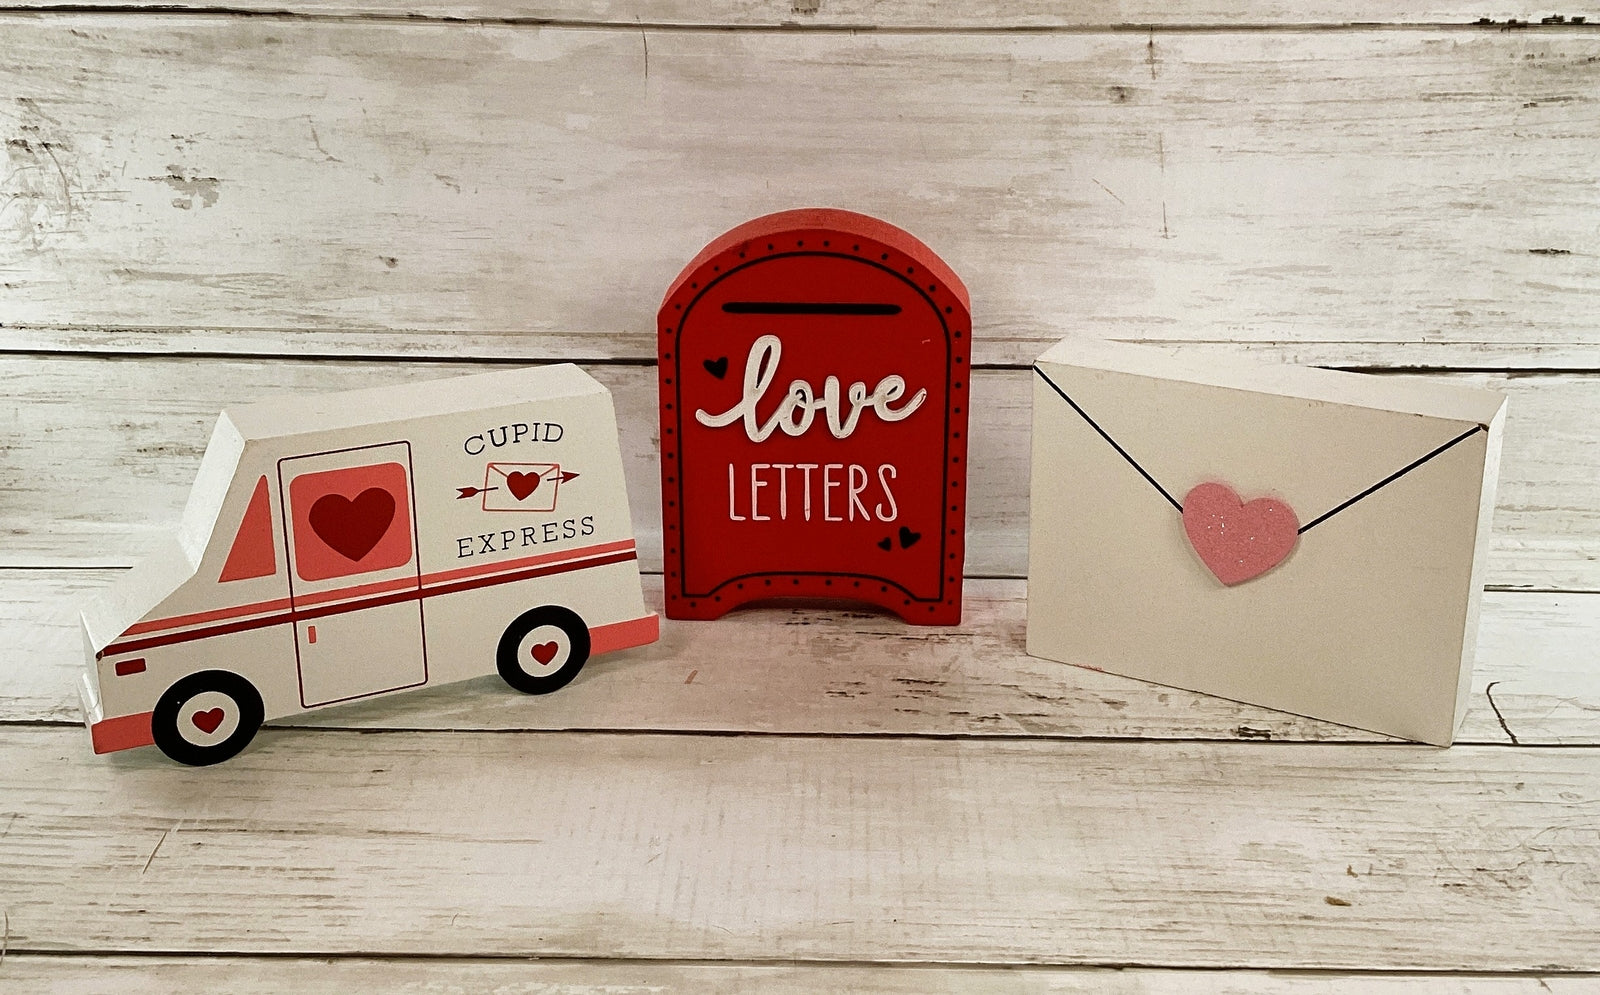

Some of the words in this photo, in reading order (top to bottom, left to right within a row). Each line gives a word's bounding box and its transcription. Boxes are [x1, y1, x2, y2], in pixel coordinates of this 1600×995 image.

[695, 334, 926, 443] love
[463, 421, 565, 456] CUPID
[728, 463, 898, 522] LETTERS
[456, 515, 597, 558] EXPRESS
